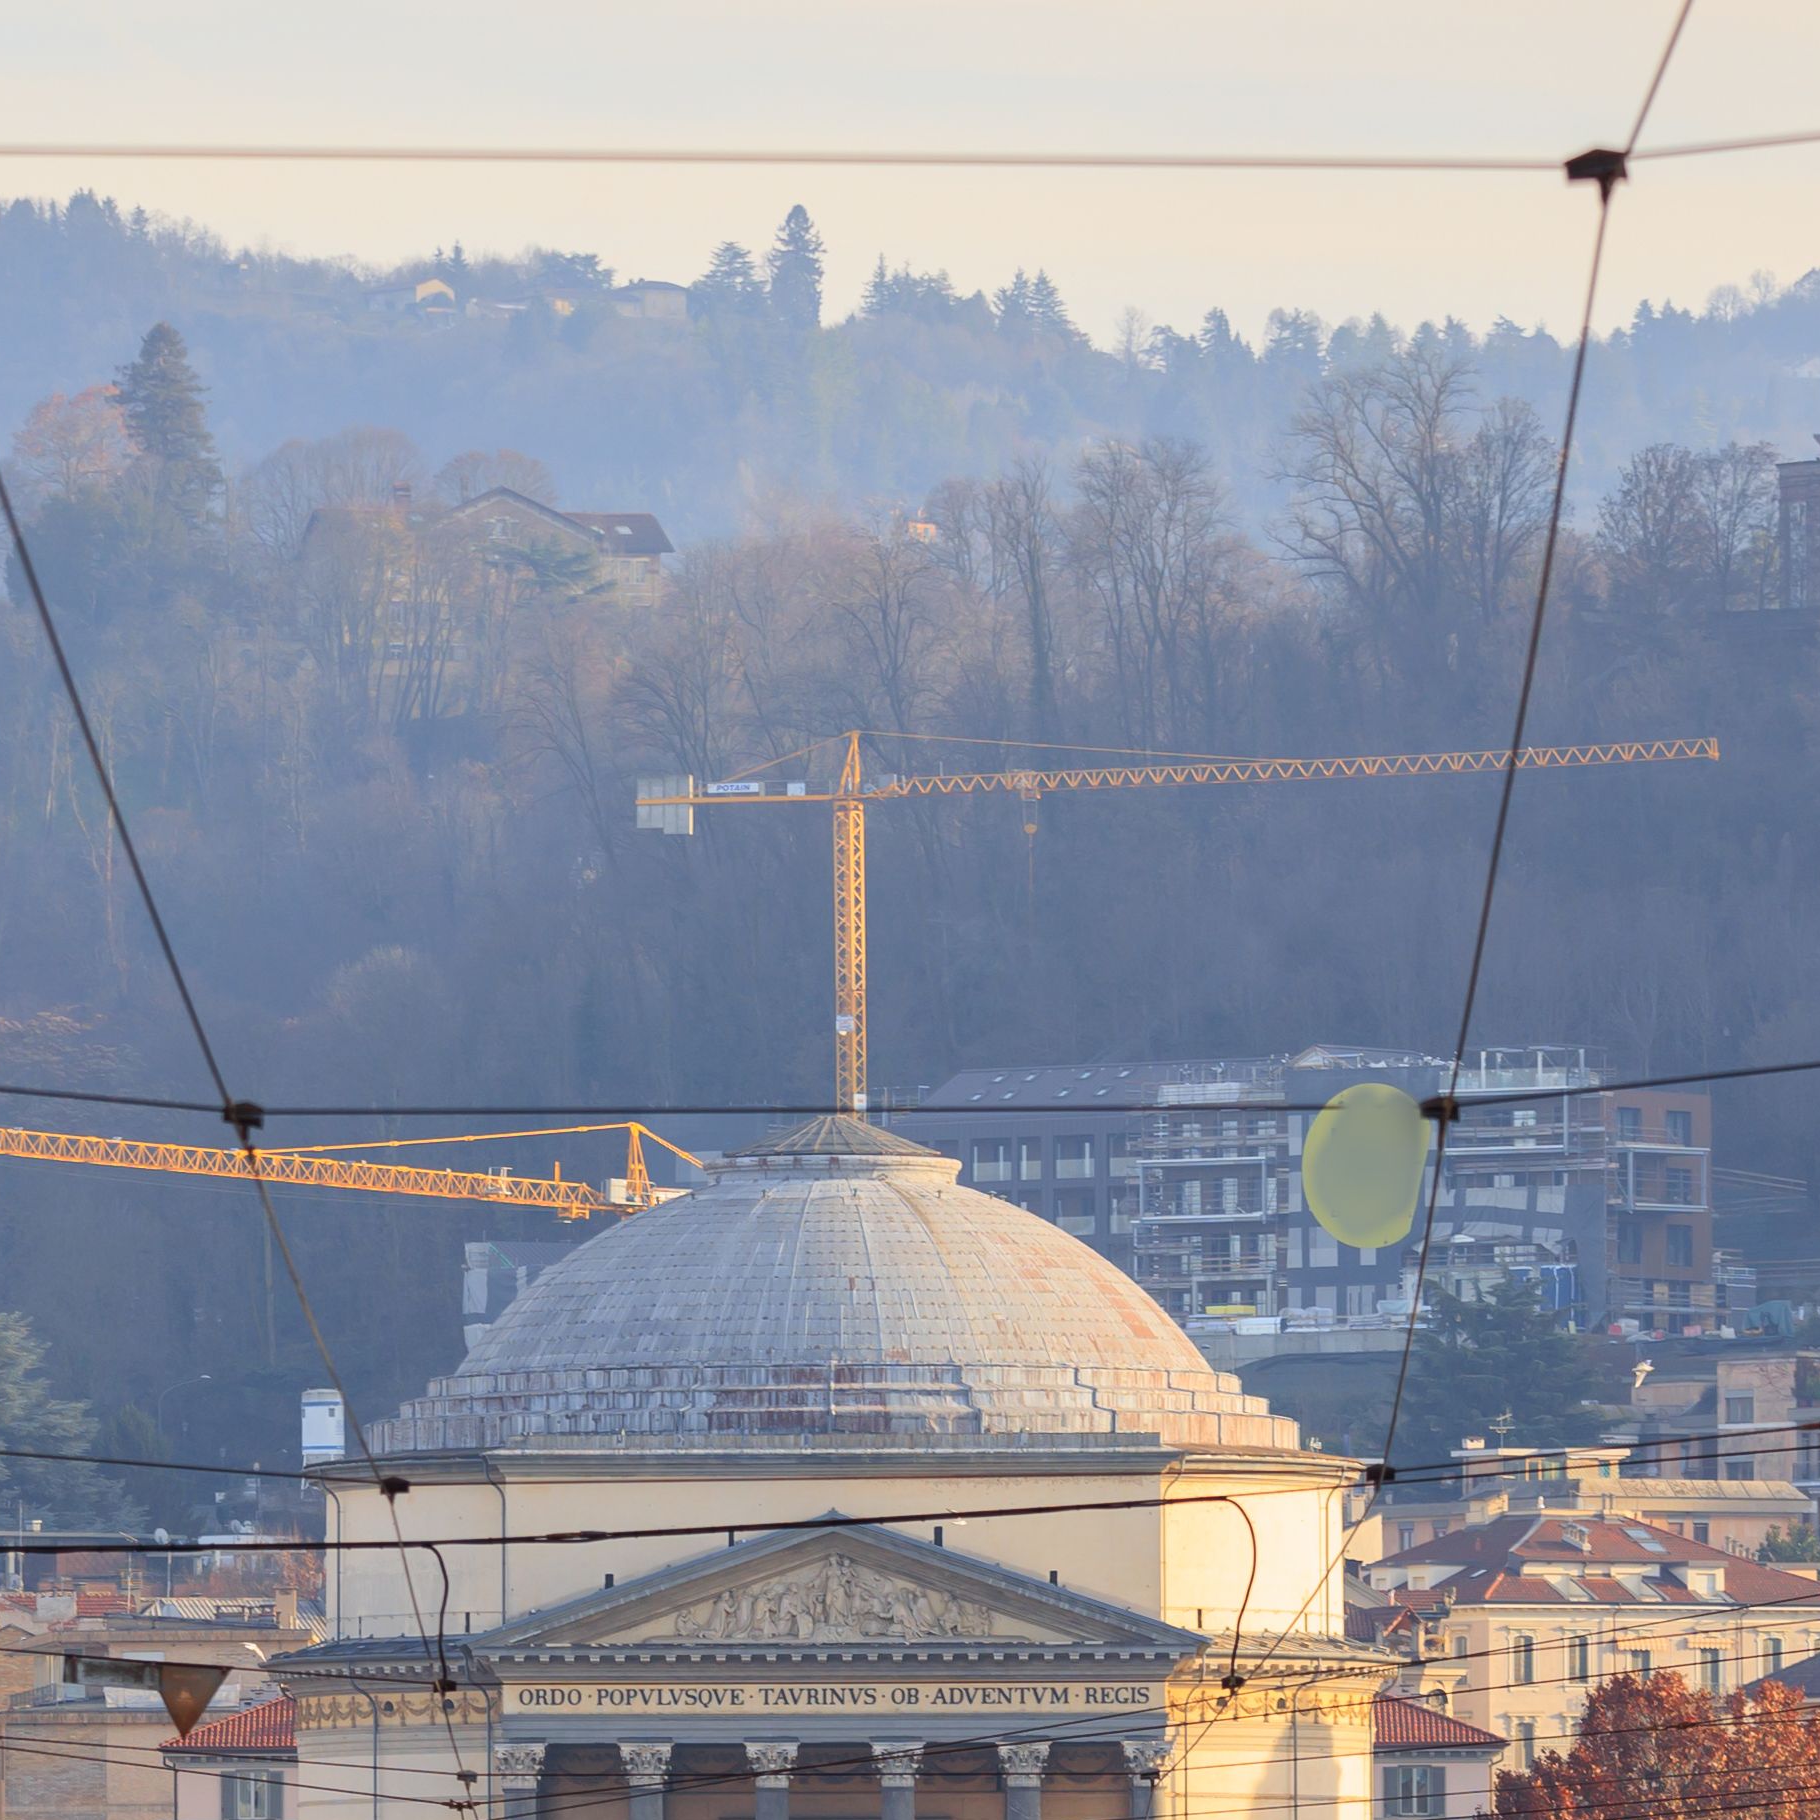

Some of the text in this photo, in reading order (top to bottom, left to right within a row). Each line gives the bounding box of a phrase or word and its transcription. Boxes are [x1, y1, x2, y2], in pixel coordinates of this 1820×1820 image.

[519, 1686, 1150, 1708] ORDO POPVLVSQVE TAVRINVS OB ADVENTVM REGIS
